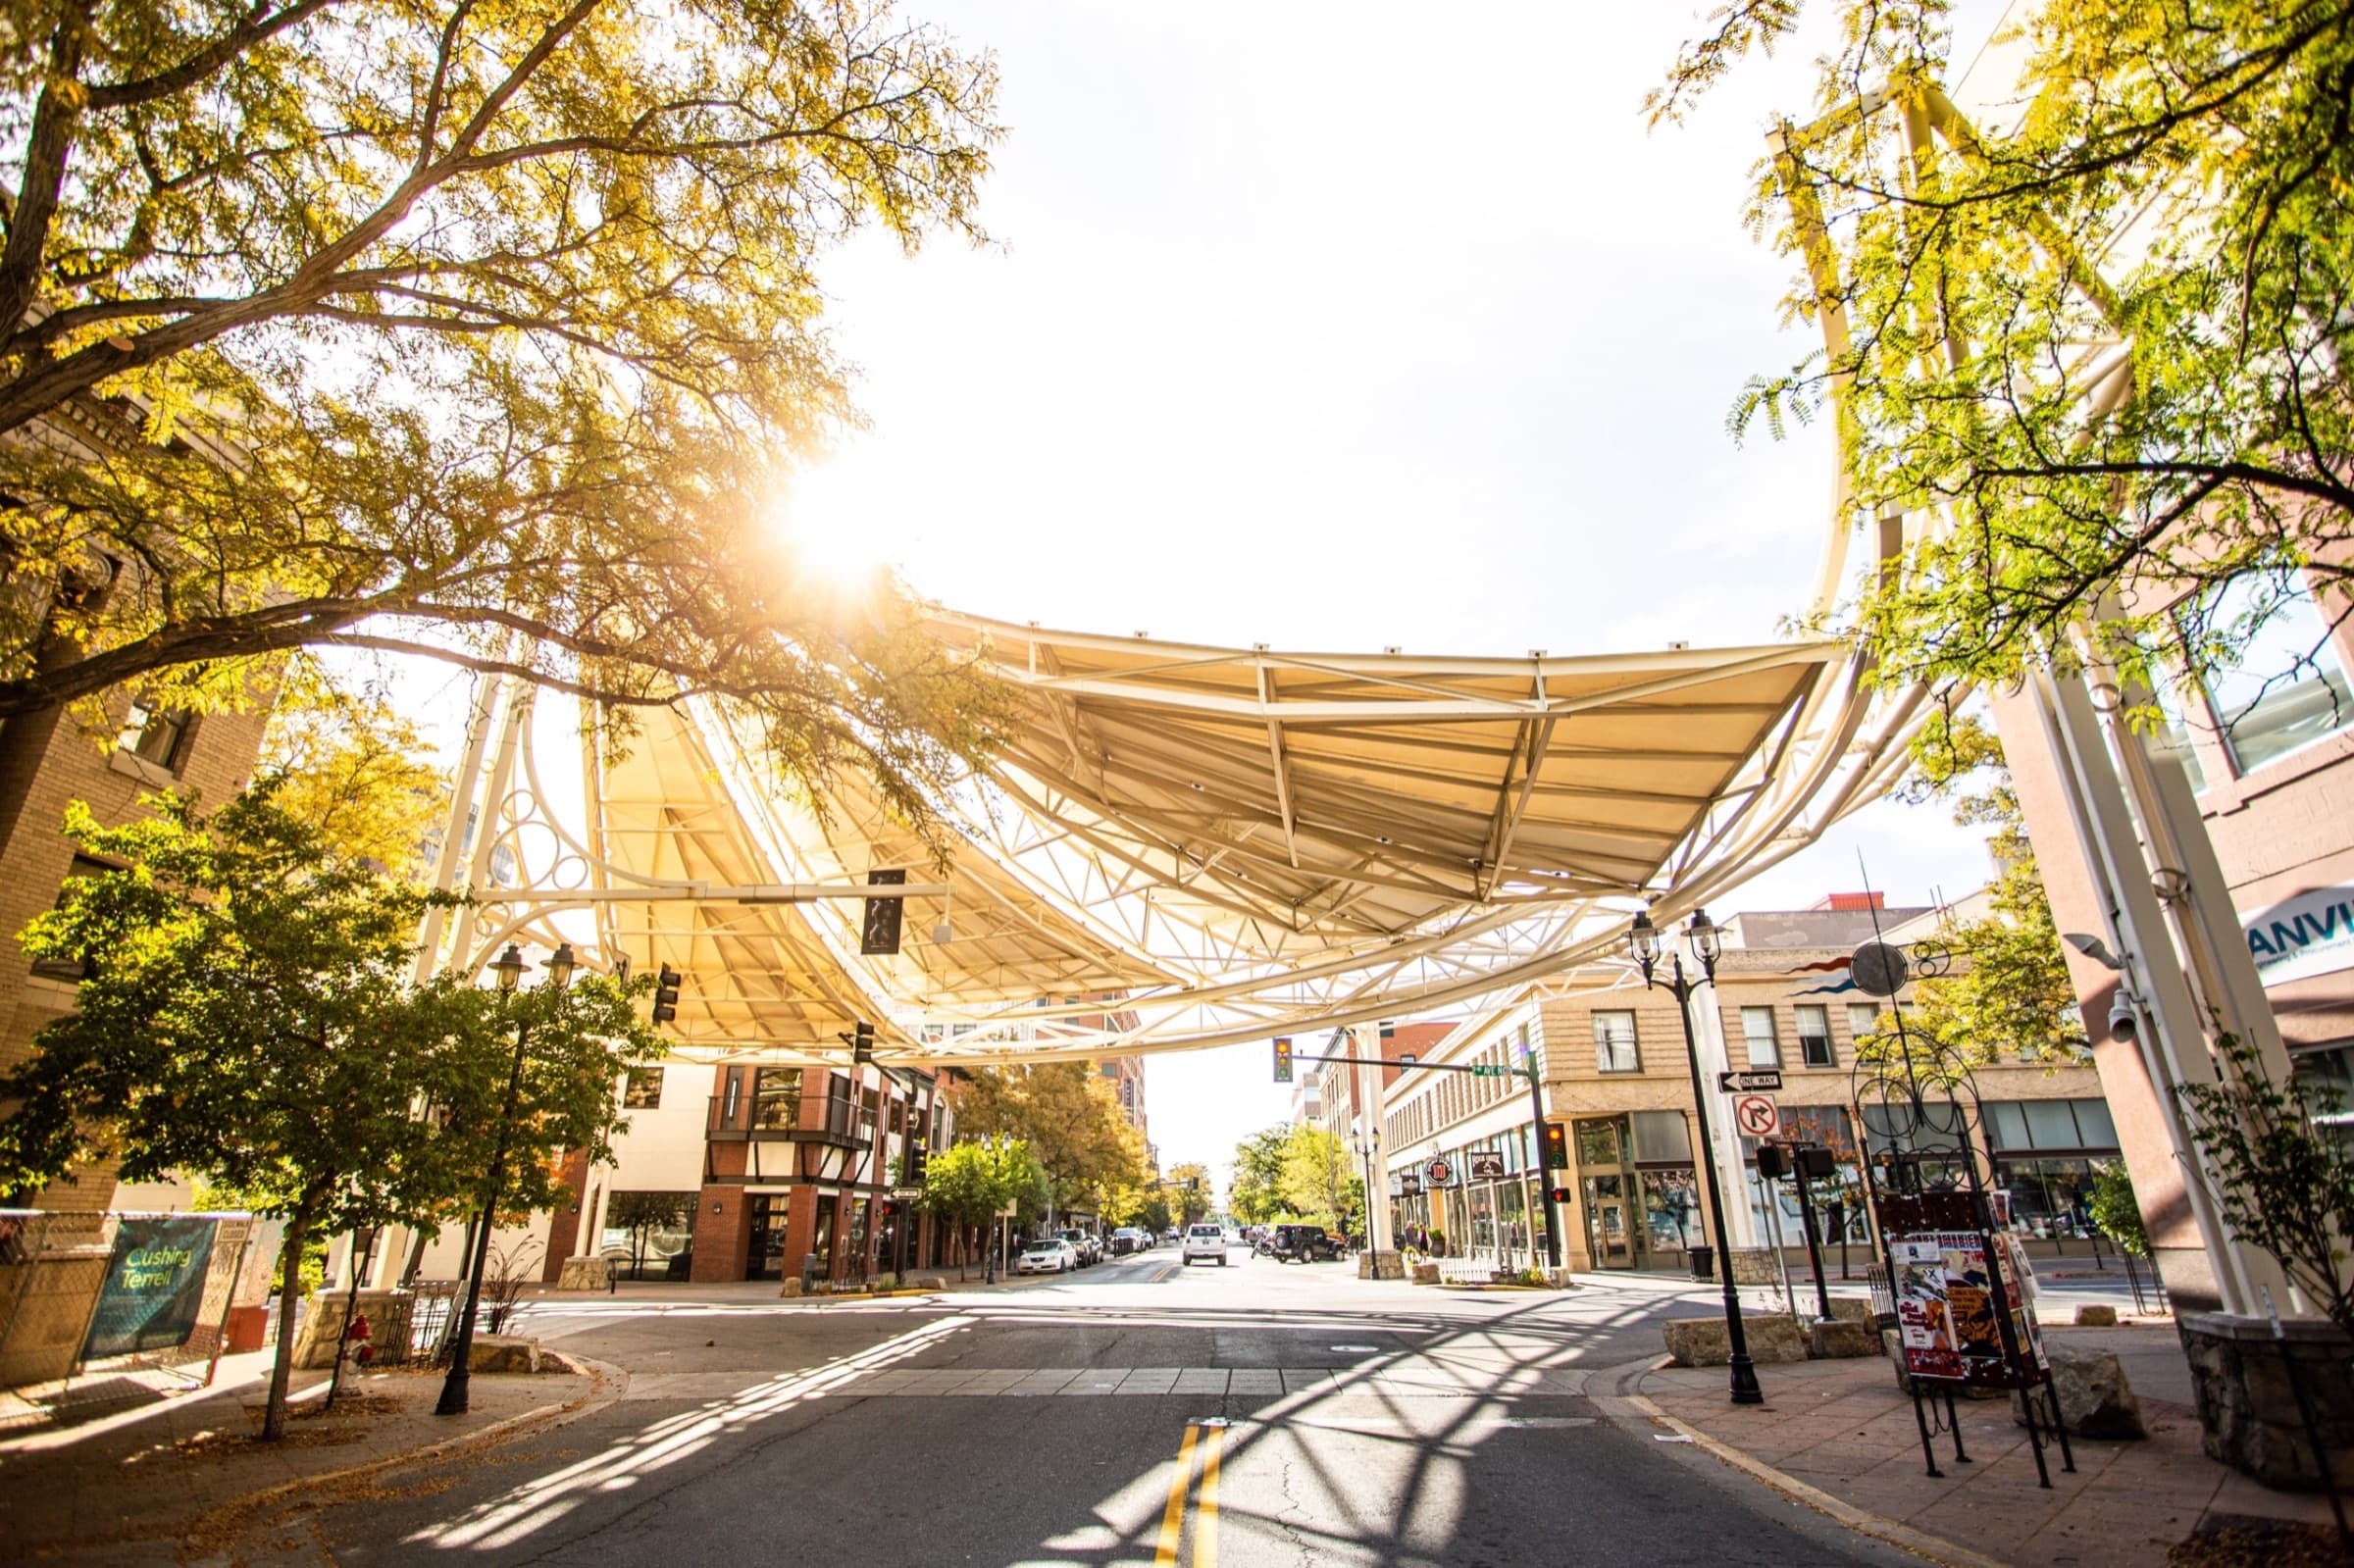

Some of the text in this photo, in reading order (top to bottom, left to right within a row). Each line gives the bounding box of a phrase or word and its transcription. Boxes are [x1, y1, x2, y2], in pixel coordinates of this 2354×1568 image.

[2247, 899, 2354, 957] ANVI
[1739, 1077, 1755, 1086] ONE
[126, 1245, 191, 1268] Cushing
[122, 1268, 173, 1289] Terrell
